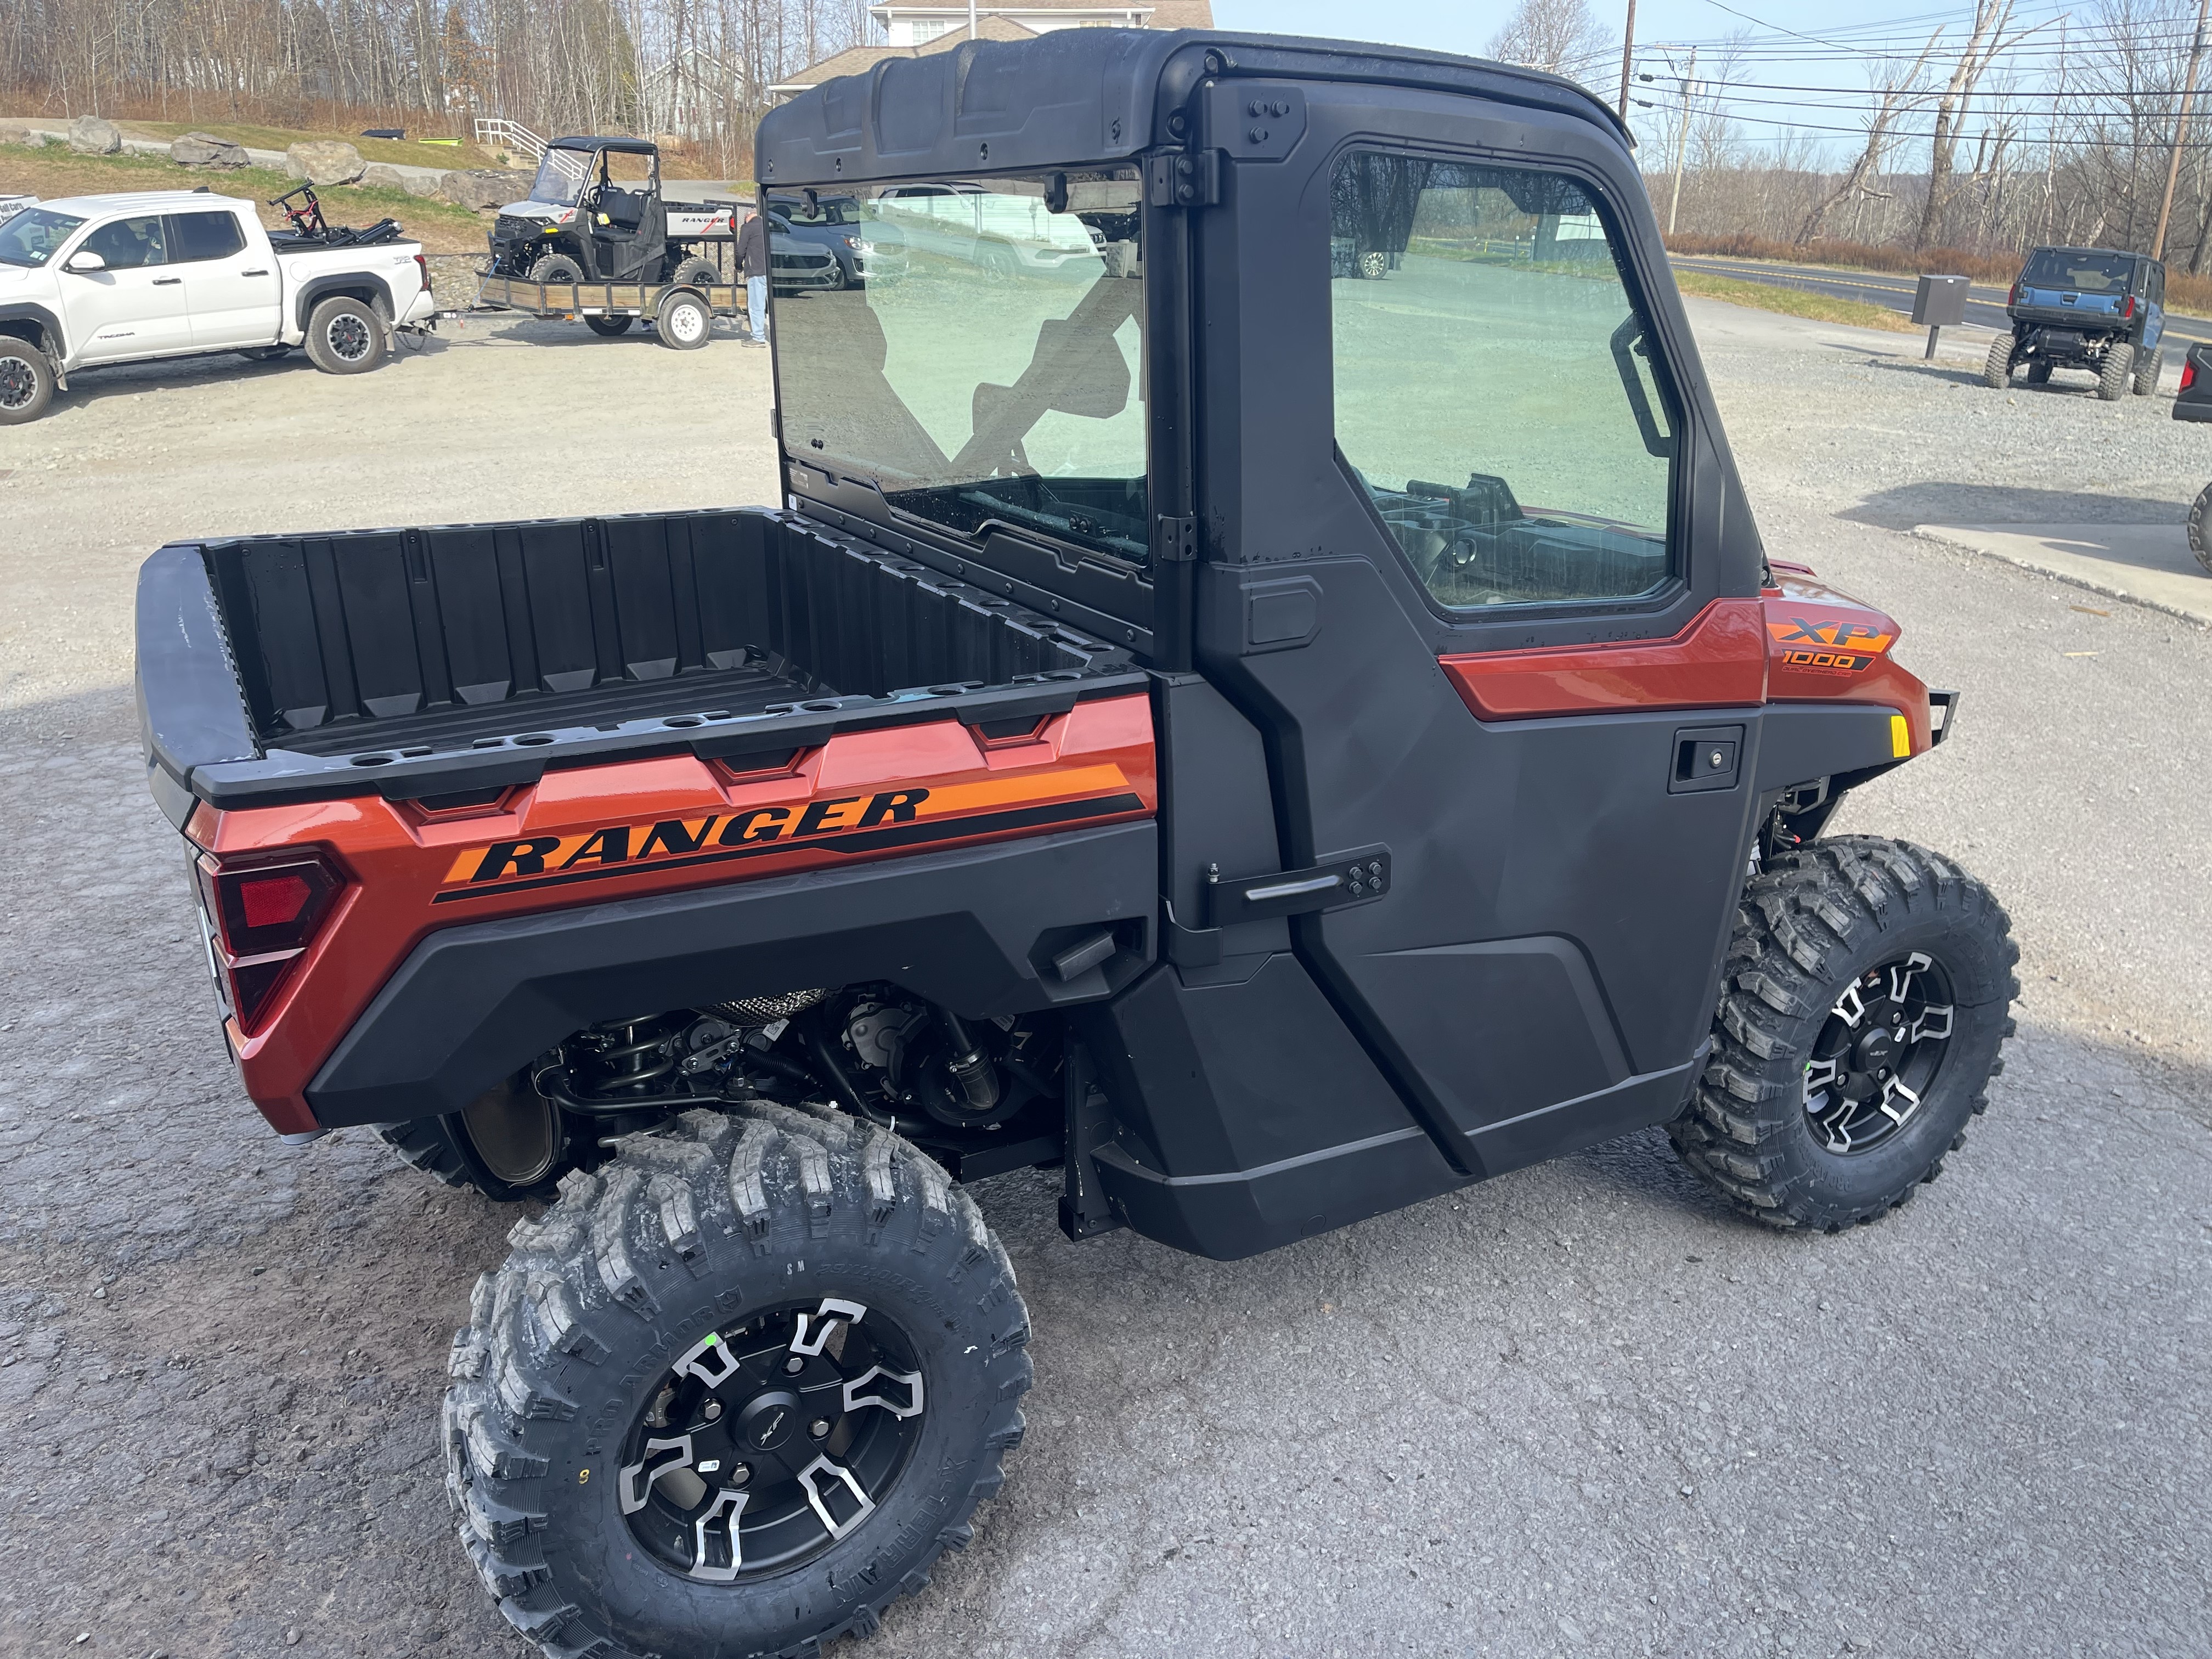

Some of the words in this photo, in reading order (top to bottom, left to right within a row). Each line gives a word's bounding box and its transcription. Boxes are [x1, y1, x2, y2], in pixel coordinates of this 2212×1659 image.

[1778, 617, 1882, 646] XP
[1782, 650, 1855, 669] 1000
[469, 788, 930, 884] RANGER
